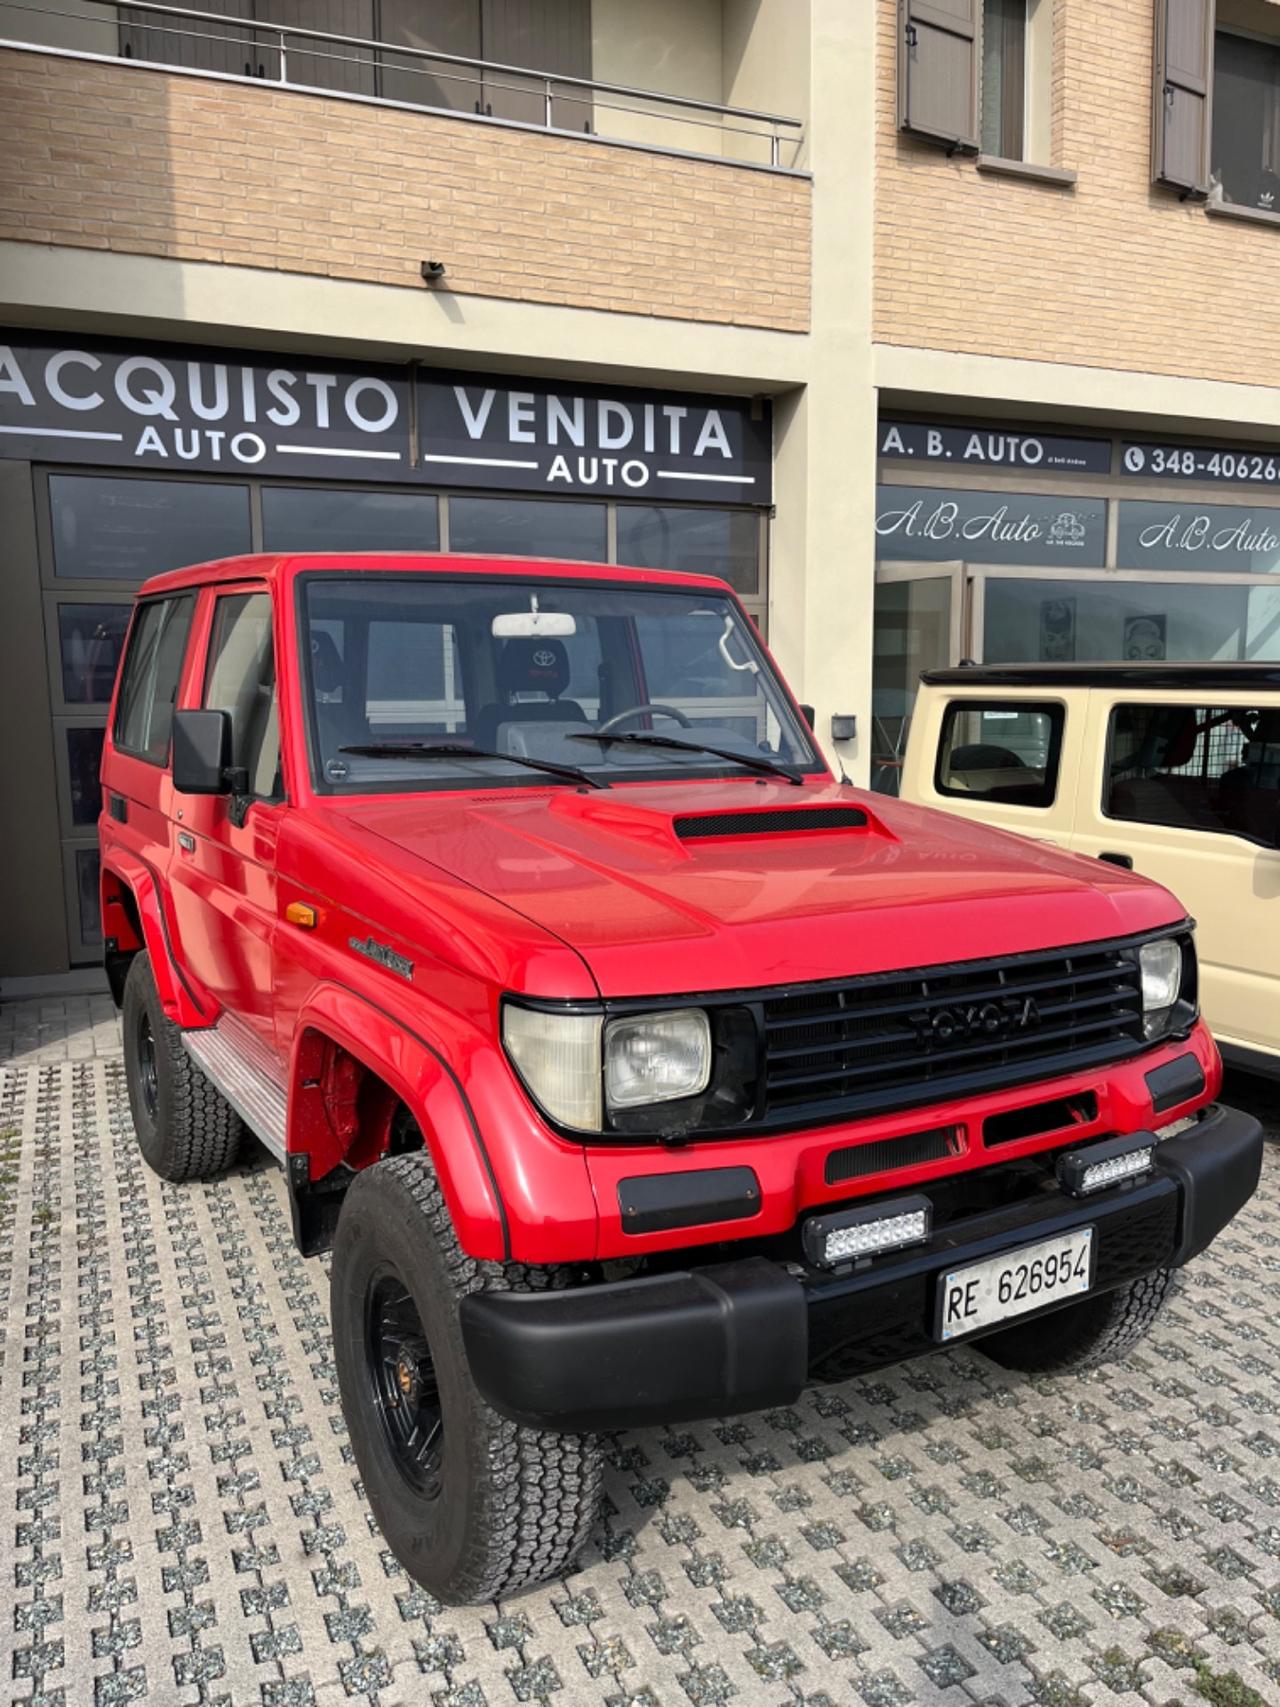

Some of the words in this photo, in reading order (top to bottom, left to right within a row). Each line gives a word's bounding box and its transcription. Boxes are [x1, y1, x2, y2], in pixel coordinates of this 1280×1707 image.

[0, 345, 399, 433] ACQUISTO
[453, 386, 732, 458] VENDITA
[135, 426, 266, 463] AUTO
[963, 434, 1043, 464] AUTO
[547, 455, 650, 487] AUTO
[1151, 447, 1280, 481] 348-40626
[947, 1279, 980, 1323] RE
[998, 1244, 1088, 1304] 626954
